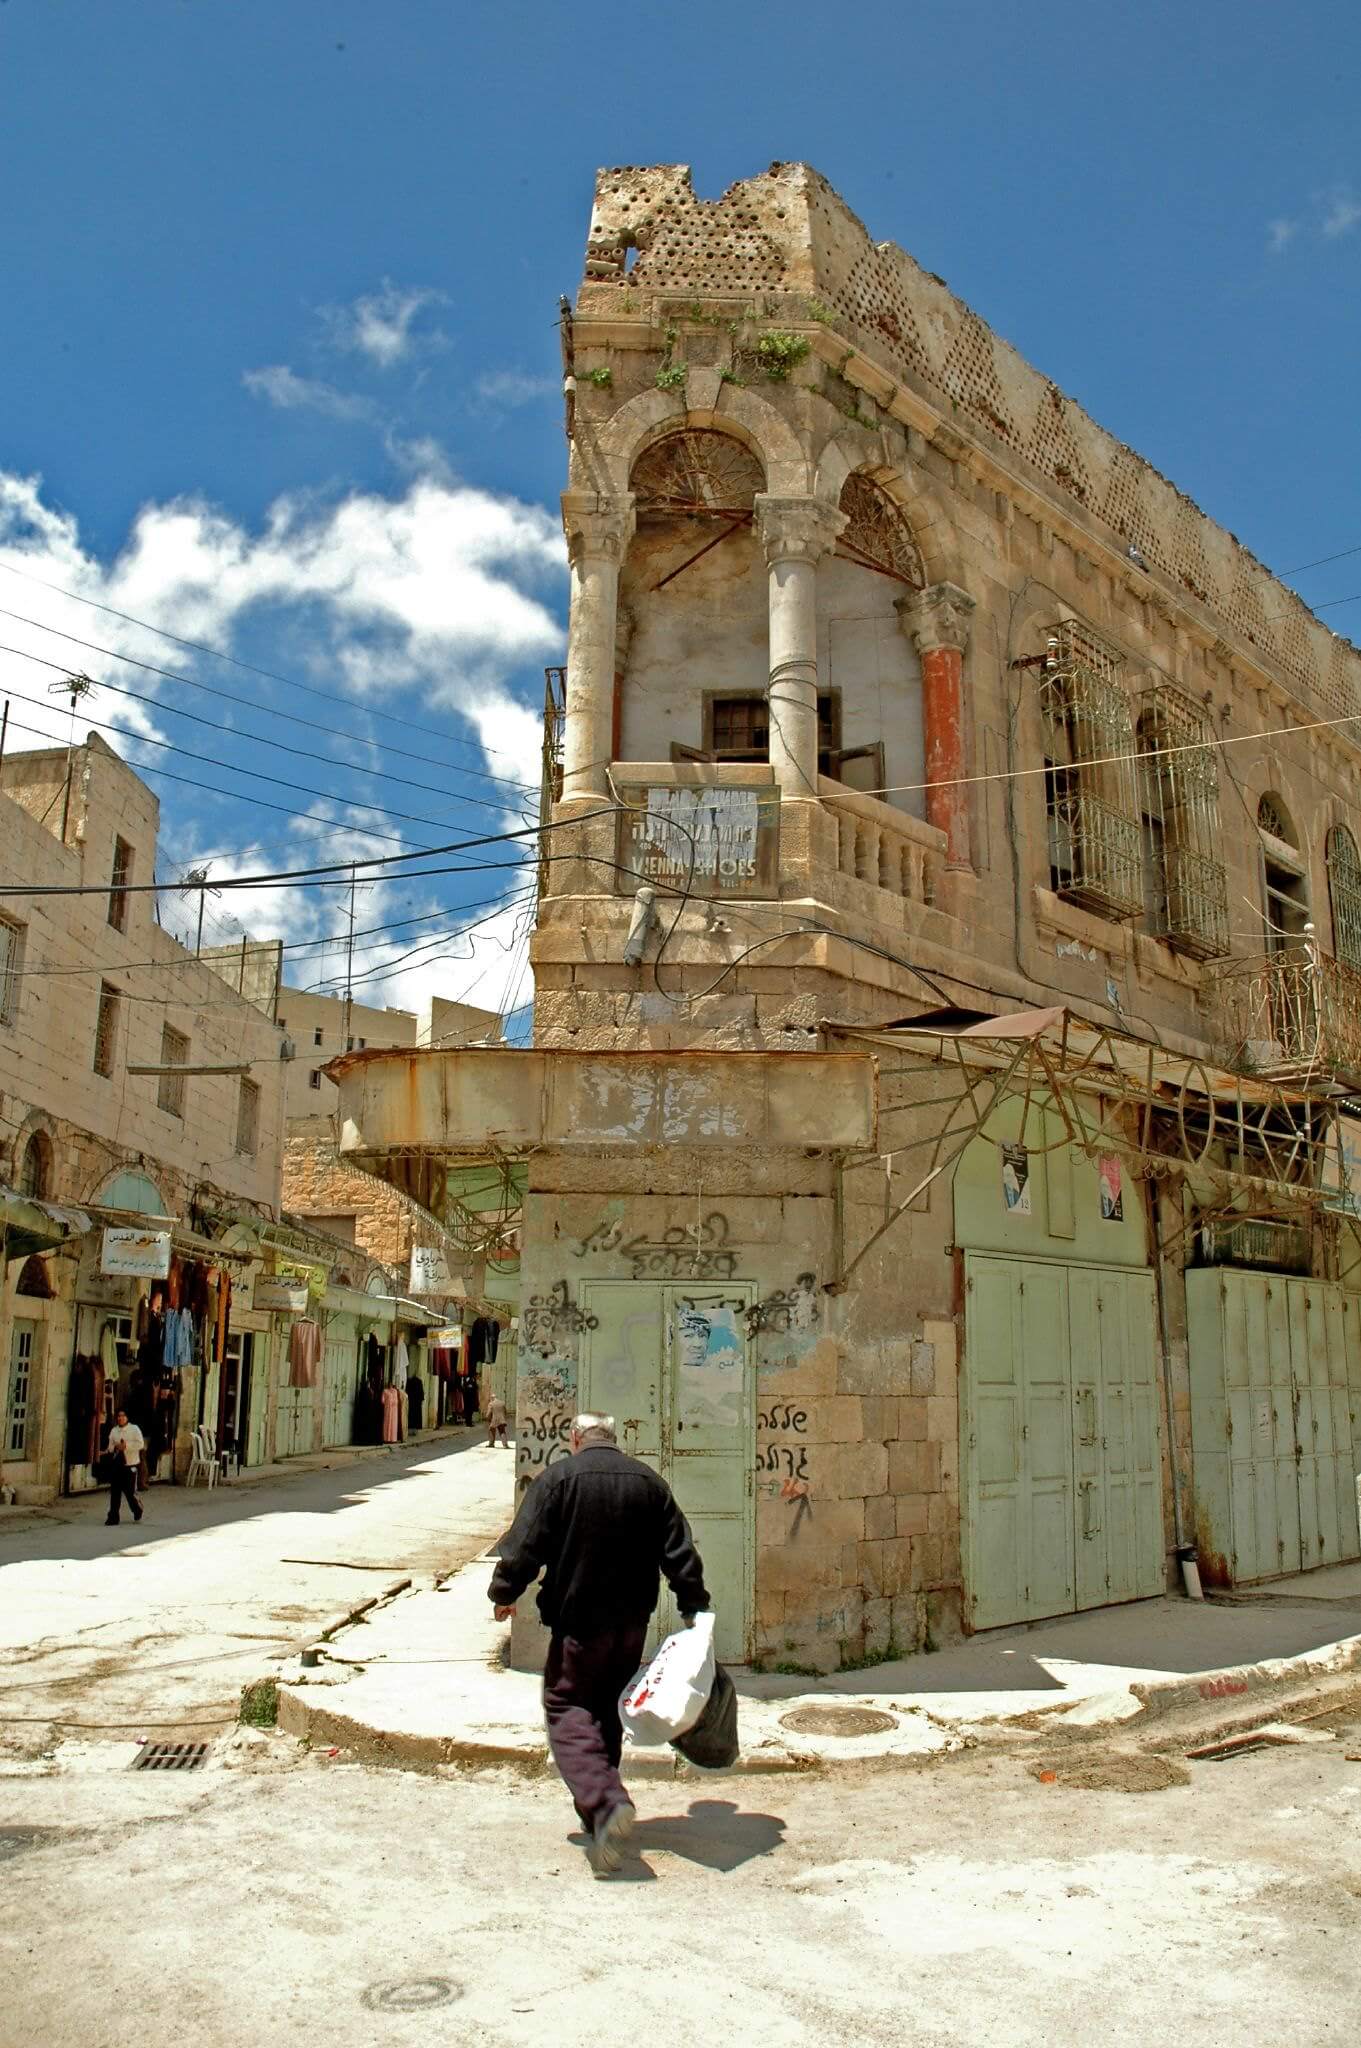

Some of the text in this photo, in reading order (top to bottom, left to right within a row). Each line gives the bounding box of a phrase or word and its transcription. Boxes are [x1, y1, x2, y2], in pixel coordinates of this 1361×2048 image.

[632, 857, 757, 877] VIENNA SHOES
[757, 1404, 807, 1433] שללה
[756, 1443, 809, 1481] גדולה
